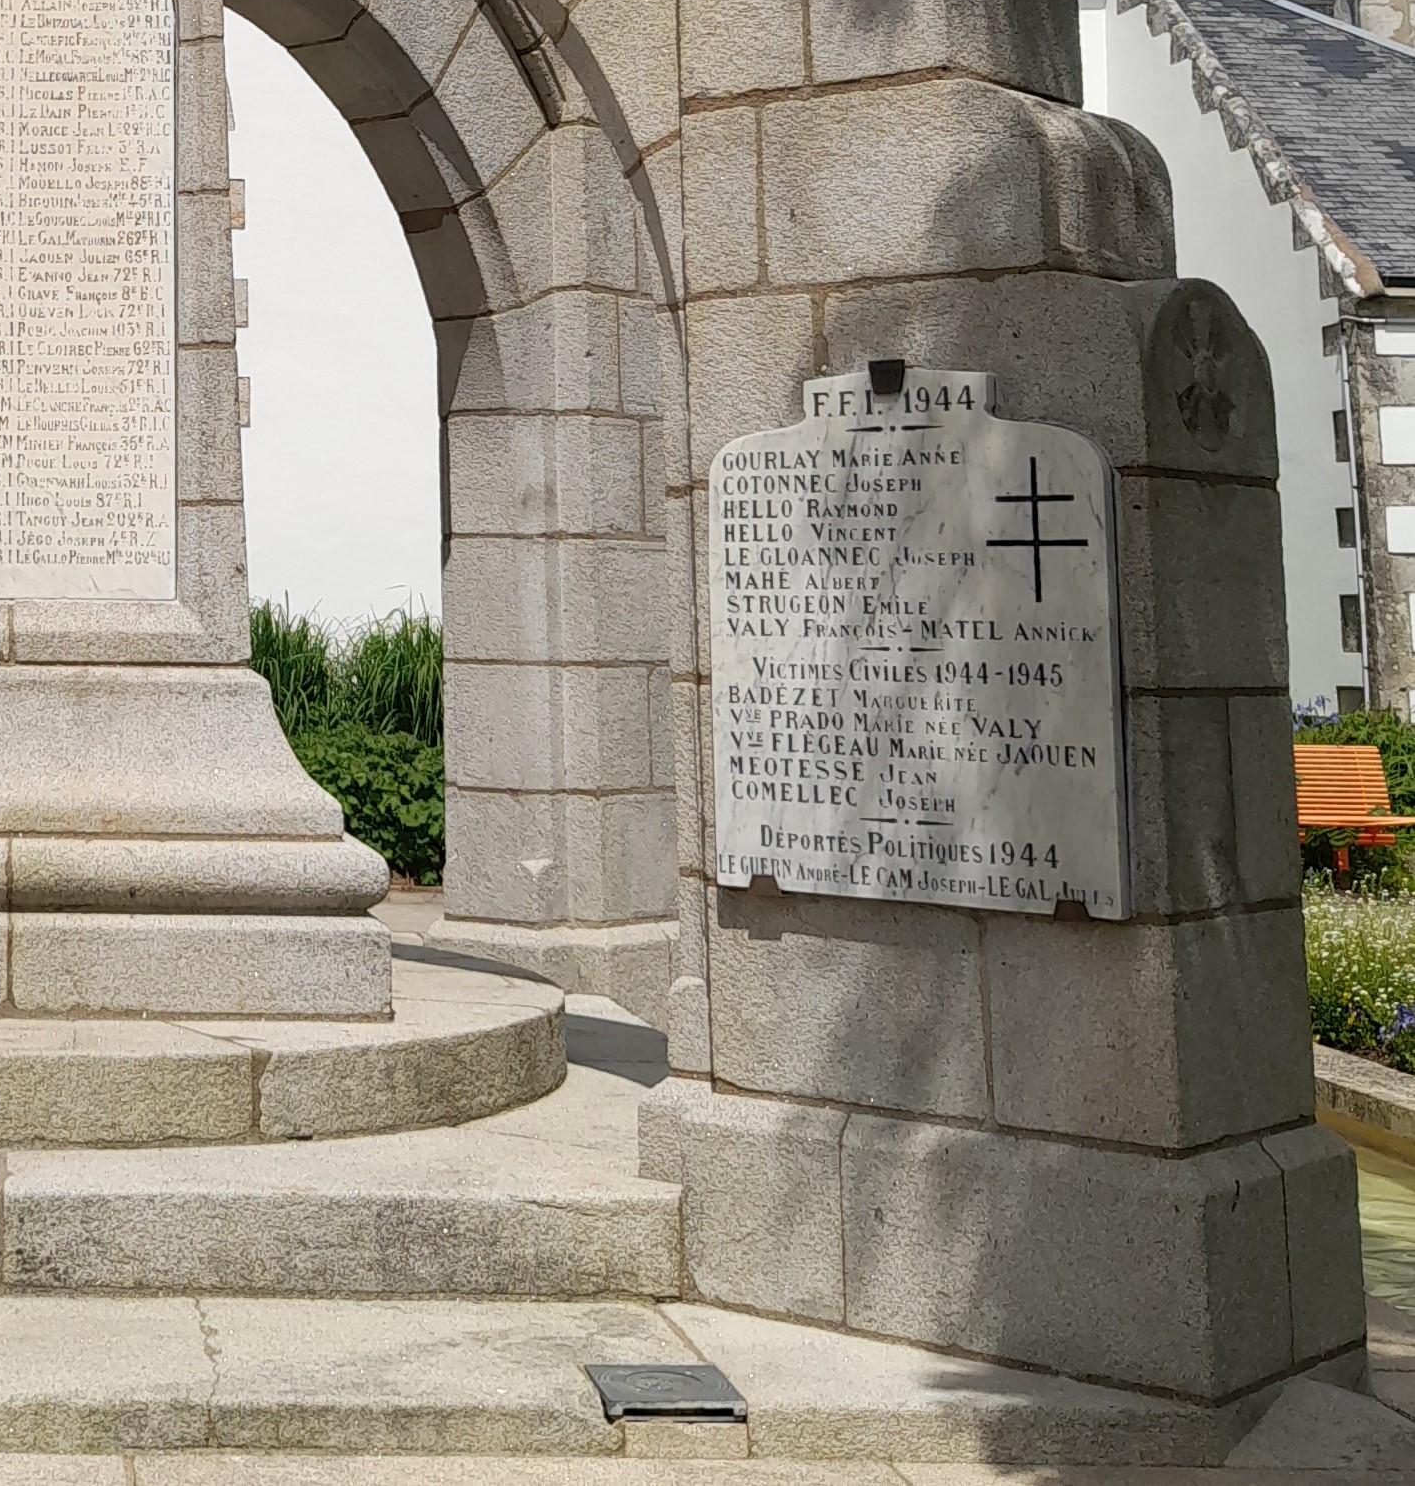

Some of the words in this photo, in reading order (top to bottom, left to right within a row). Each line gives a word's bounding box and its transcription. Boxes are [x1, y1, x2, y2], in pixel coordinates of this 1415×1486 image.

[904, 385, 975, 413] 1944
[723, 450, 820, 471] GOURLAY
[723, 474, 836, 495] COTONNEC
[724, 500, 792, 519] HELLO
[725, 524, 792, 542] HELLO
[725, 548, 750, 566] LE
[760, 547, 879, 566] GLOANNEC
[727, 595, 844, 614] STRUGEON
[727, 618, 789, 636] VALY
[921, 618, 1003, 641] MATEL
[771, 710, 843, 730] PRADO
[971, 717, 1041, 739] VALY
[997, 744, 1095, 767] JAOUEN
[732, 780, 857, 806] COMELLEC
[990, 842, 1059, 868] 1944
[719, 854, 736, 874] LE
[877, 867, 912, 889] CAM
[1015, 878, 1052, 901] GAL
